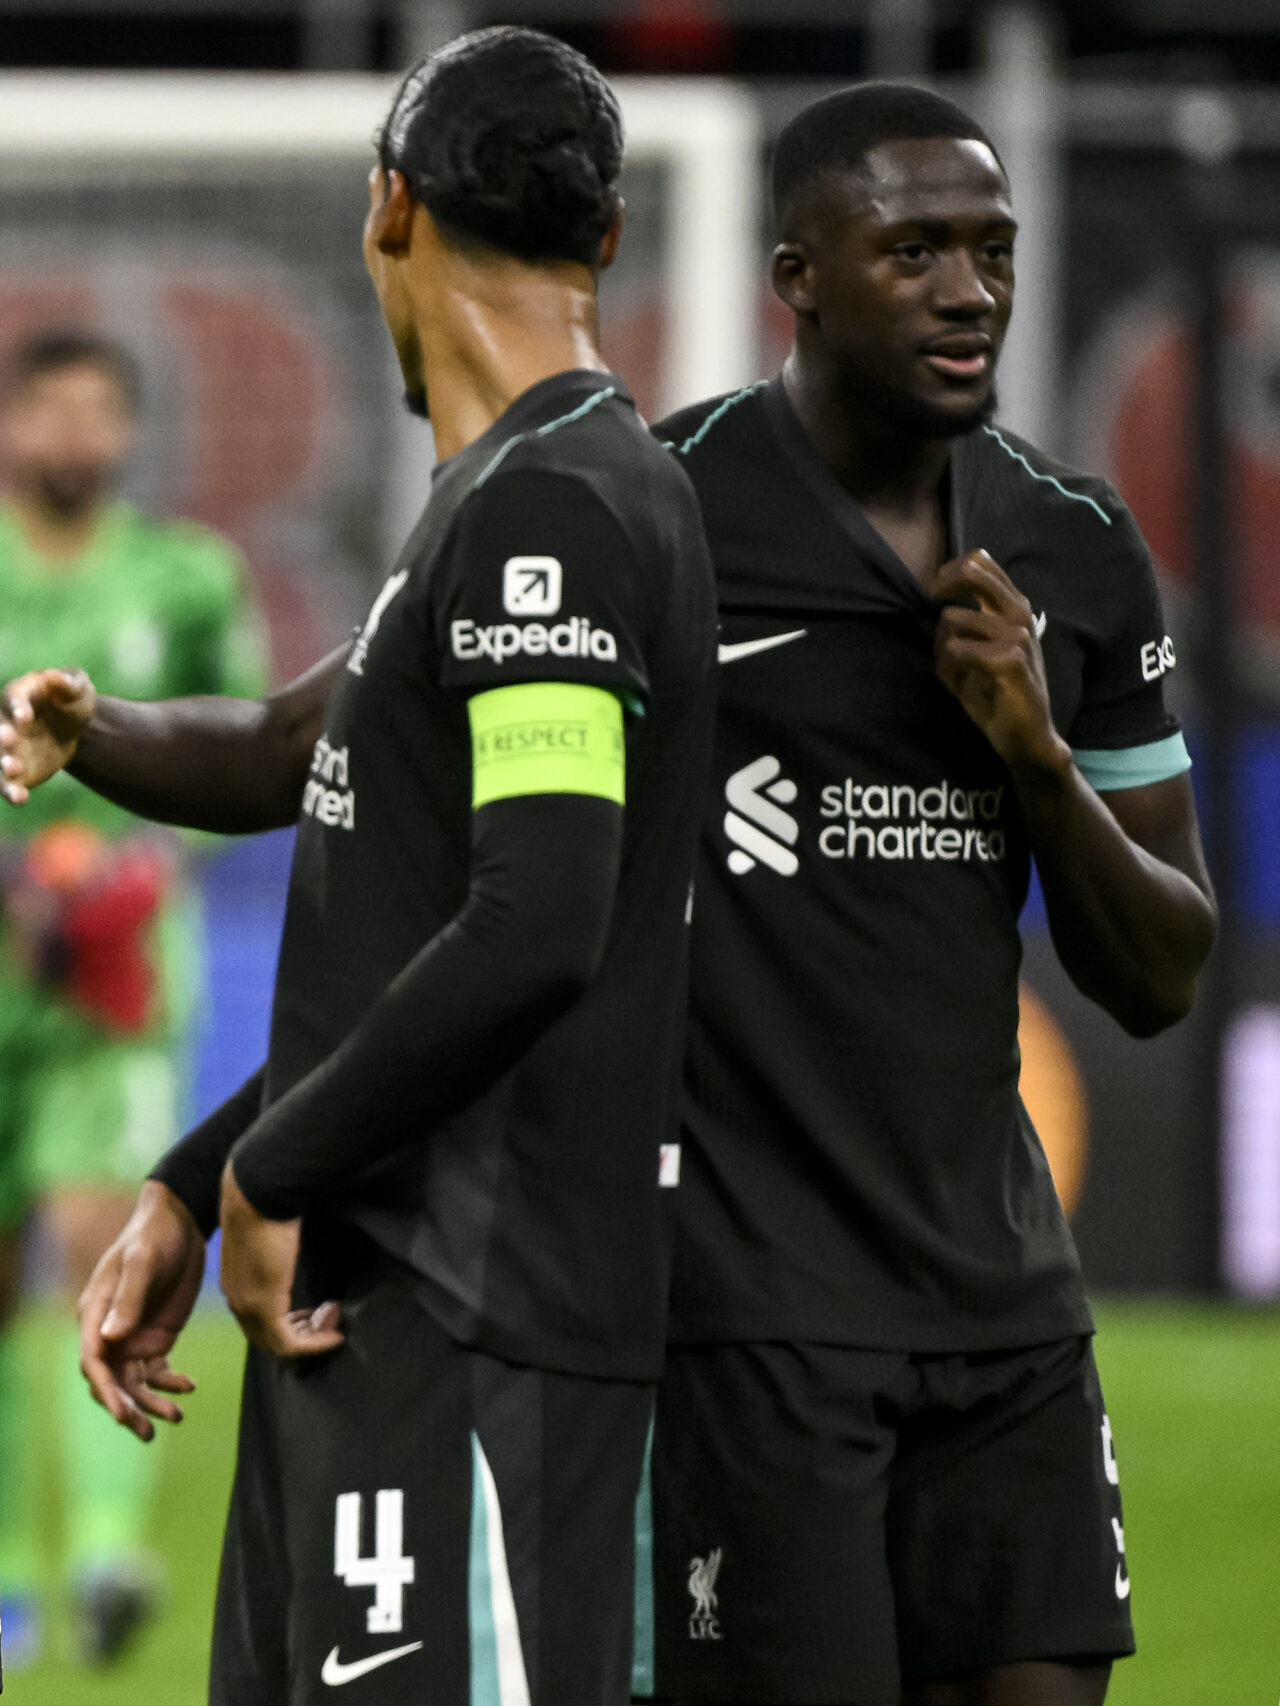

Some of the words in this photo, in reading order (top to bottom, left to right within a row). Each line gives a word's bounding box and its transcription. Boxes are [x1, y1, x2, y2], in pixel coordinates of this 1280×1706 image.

[451, 617, 618, 664] Expedia
[494, 724, 587, 751] RESPECT
[820, 777, 1004, 819] standard
[819, 818, 1005, 861] chartered
[334, 1489, 415, 1633] 4
